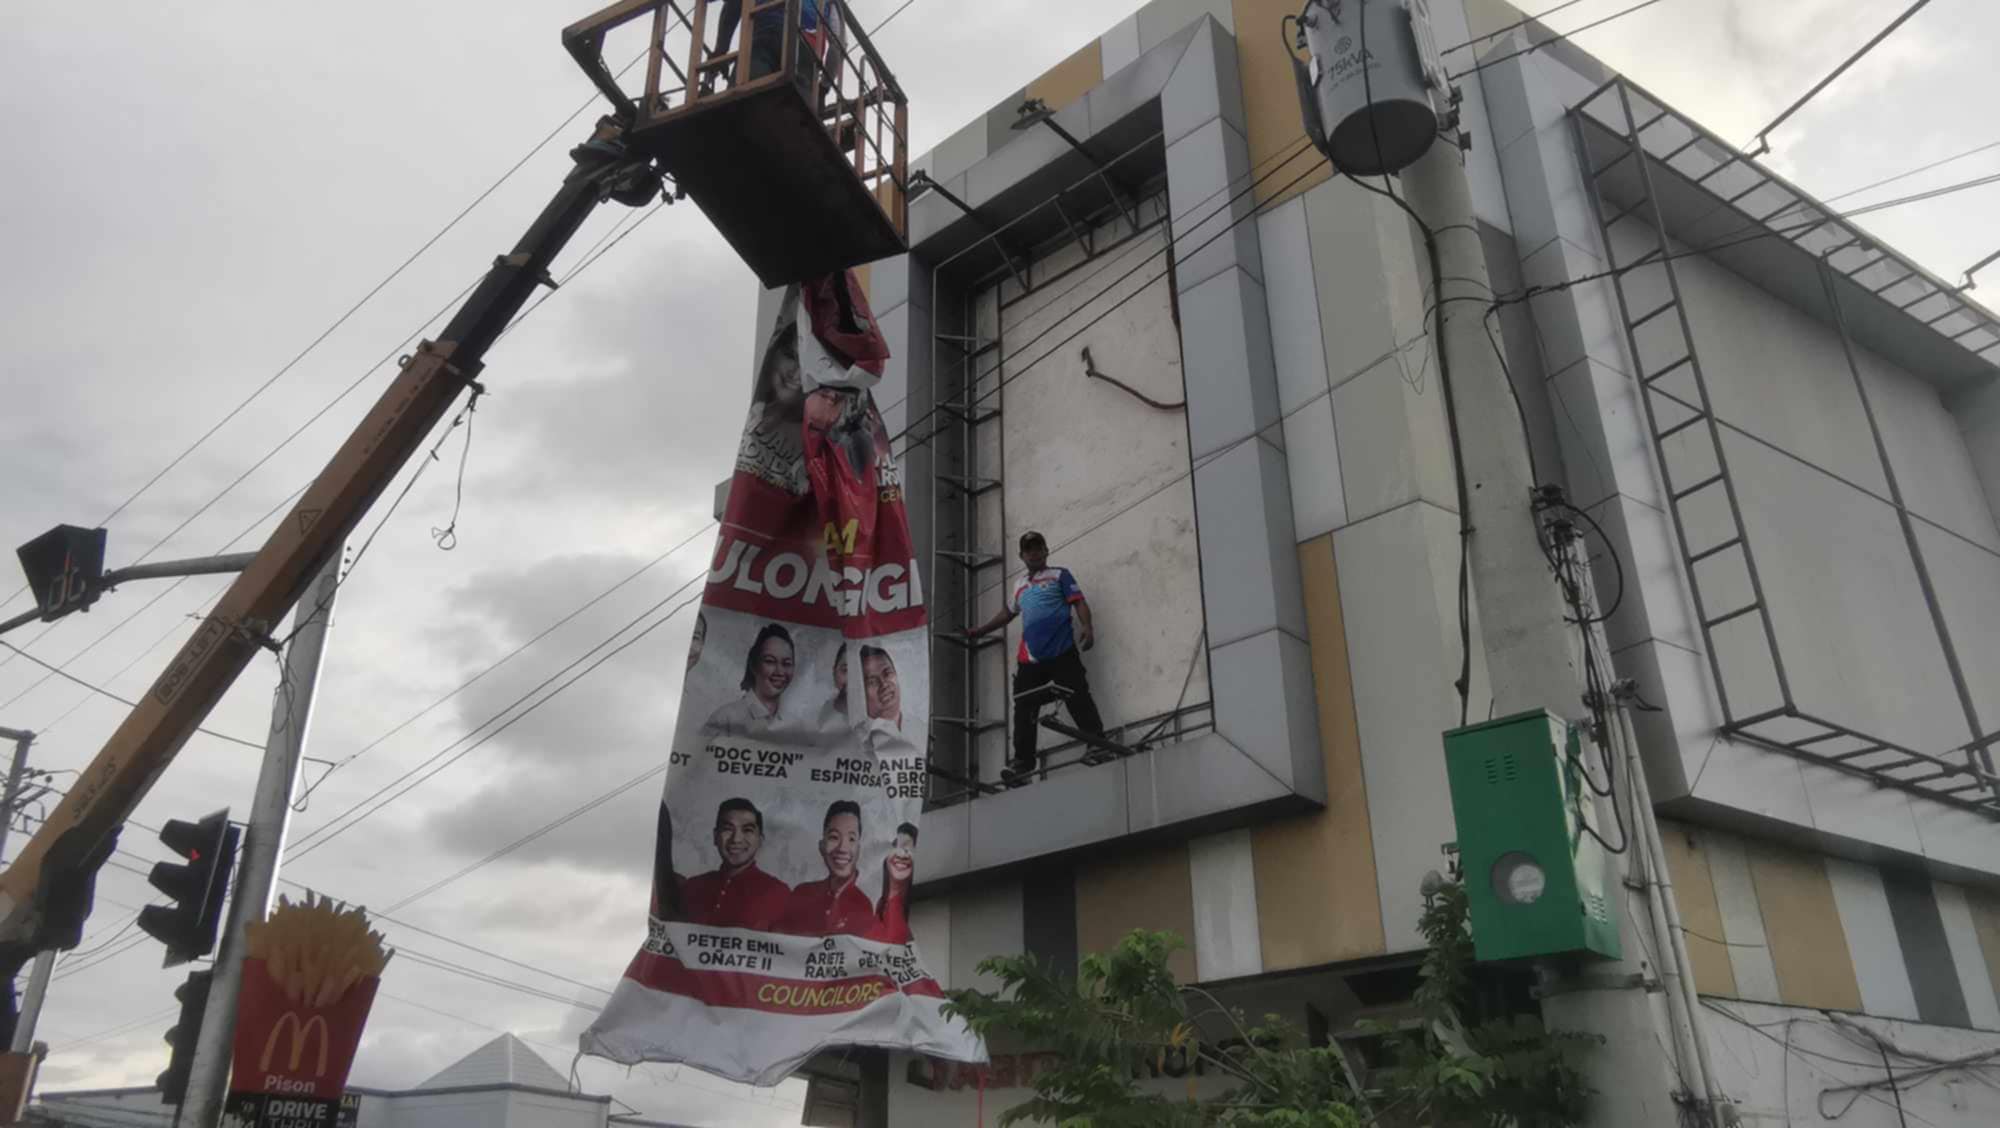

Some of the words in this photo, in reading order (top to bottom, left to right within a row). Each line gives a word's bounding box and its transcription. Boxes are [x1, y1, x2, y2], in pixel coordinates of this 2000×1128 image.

[705, 745, 751, 762] "DOC
[757, 750, 803, 766] VON"
[717, 761, 788, 779] DEVEZA
[687, 933, 743, 950] PETER
[746, 938, 784, 956] EMIL
[698, 949, 758, 969] OÑATE
[757, 981, 884, 1008] COUNCILORS
[264, 1074, 316, 1094] Pison
[268, 1101, 328, 1120] DRIVE
